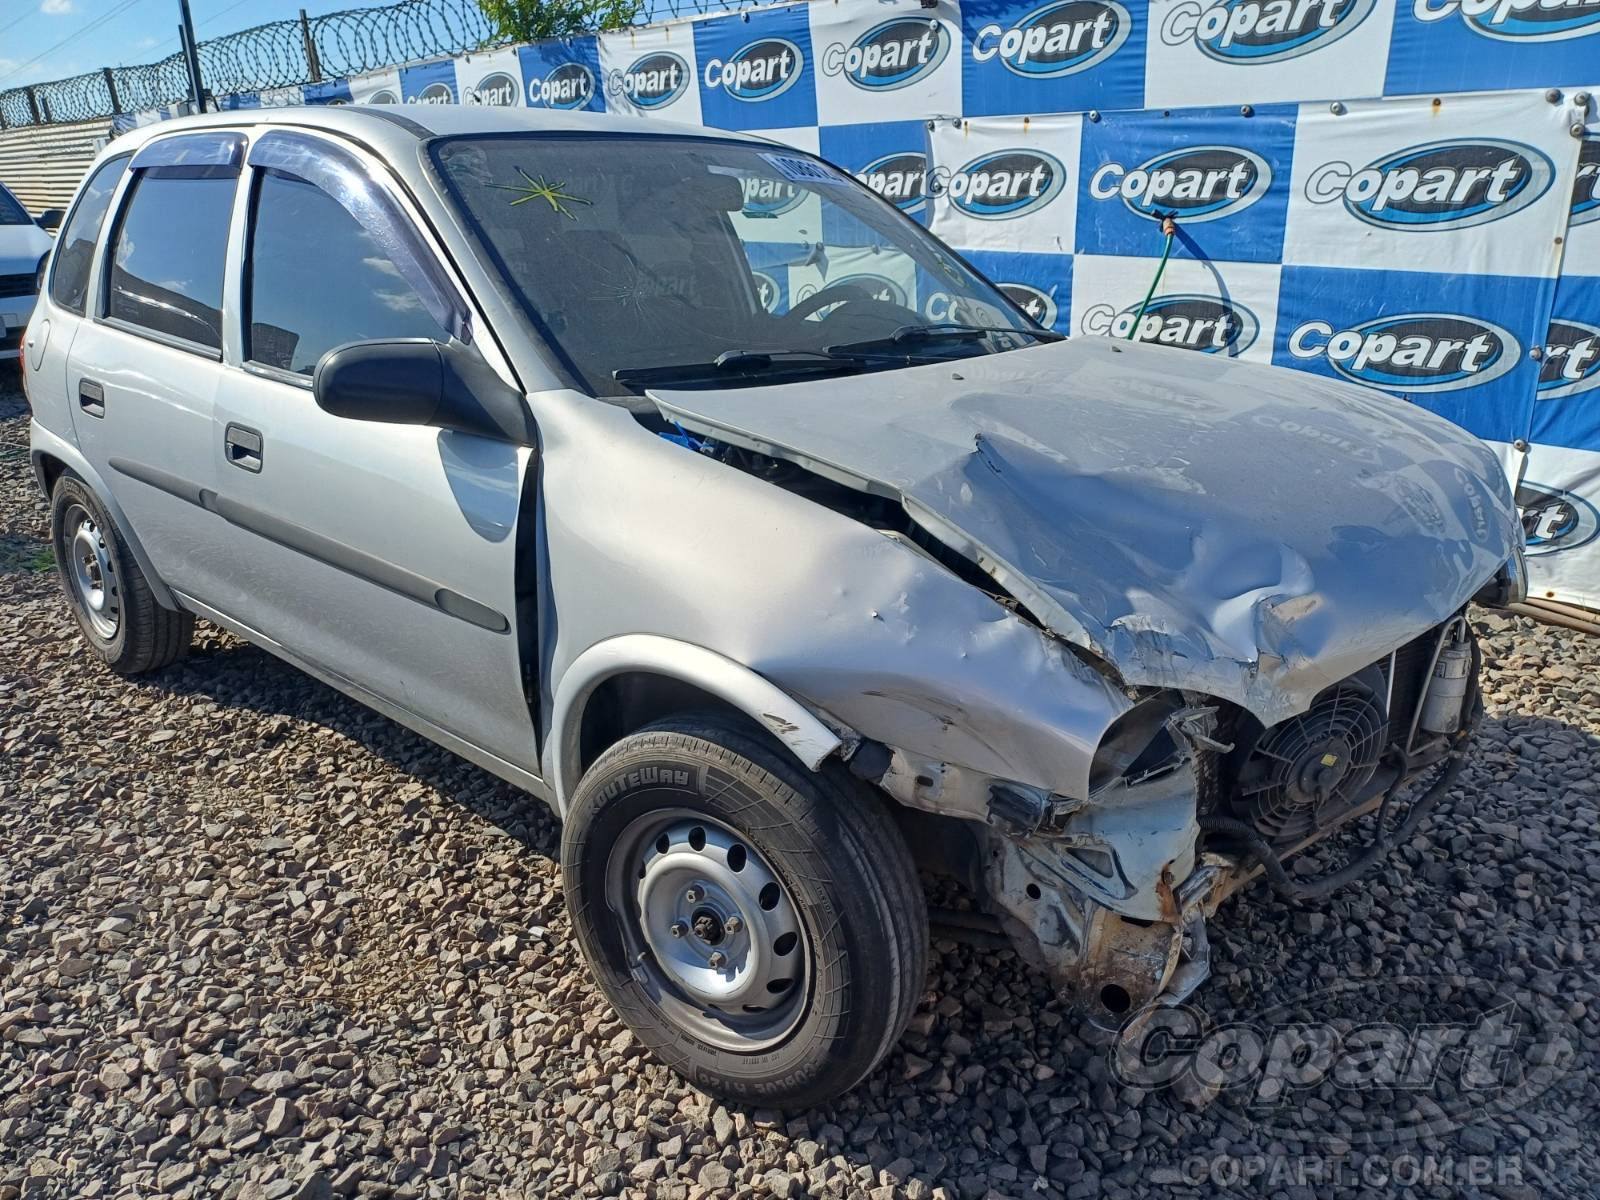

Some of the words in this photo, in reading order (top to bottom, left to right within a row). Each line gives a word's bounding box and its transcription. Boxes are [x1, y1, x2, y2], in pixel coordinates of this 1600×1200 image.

[972, 7, 1113, 64] Copart
[1160, 0, 1340, 48] Copart
[704, 48, 791, 91] Copart
[822, 28, 934, 78] Copart
[528, 71, 587, 105] Copart
[608, 62, 679, 98] Copart
[925, 161, 1048, 206] Copart
[1089, 157, 1253, 207] Copart
[1305, 154, 1522, 212] Copart
[1081, 303, 1234, 347] Copart
[1288, 319, 1495, 373] Copart
